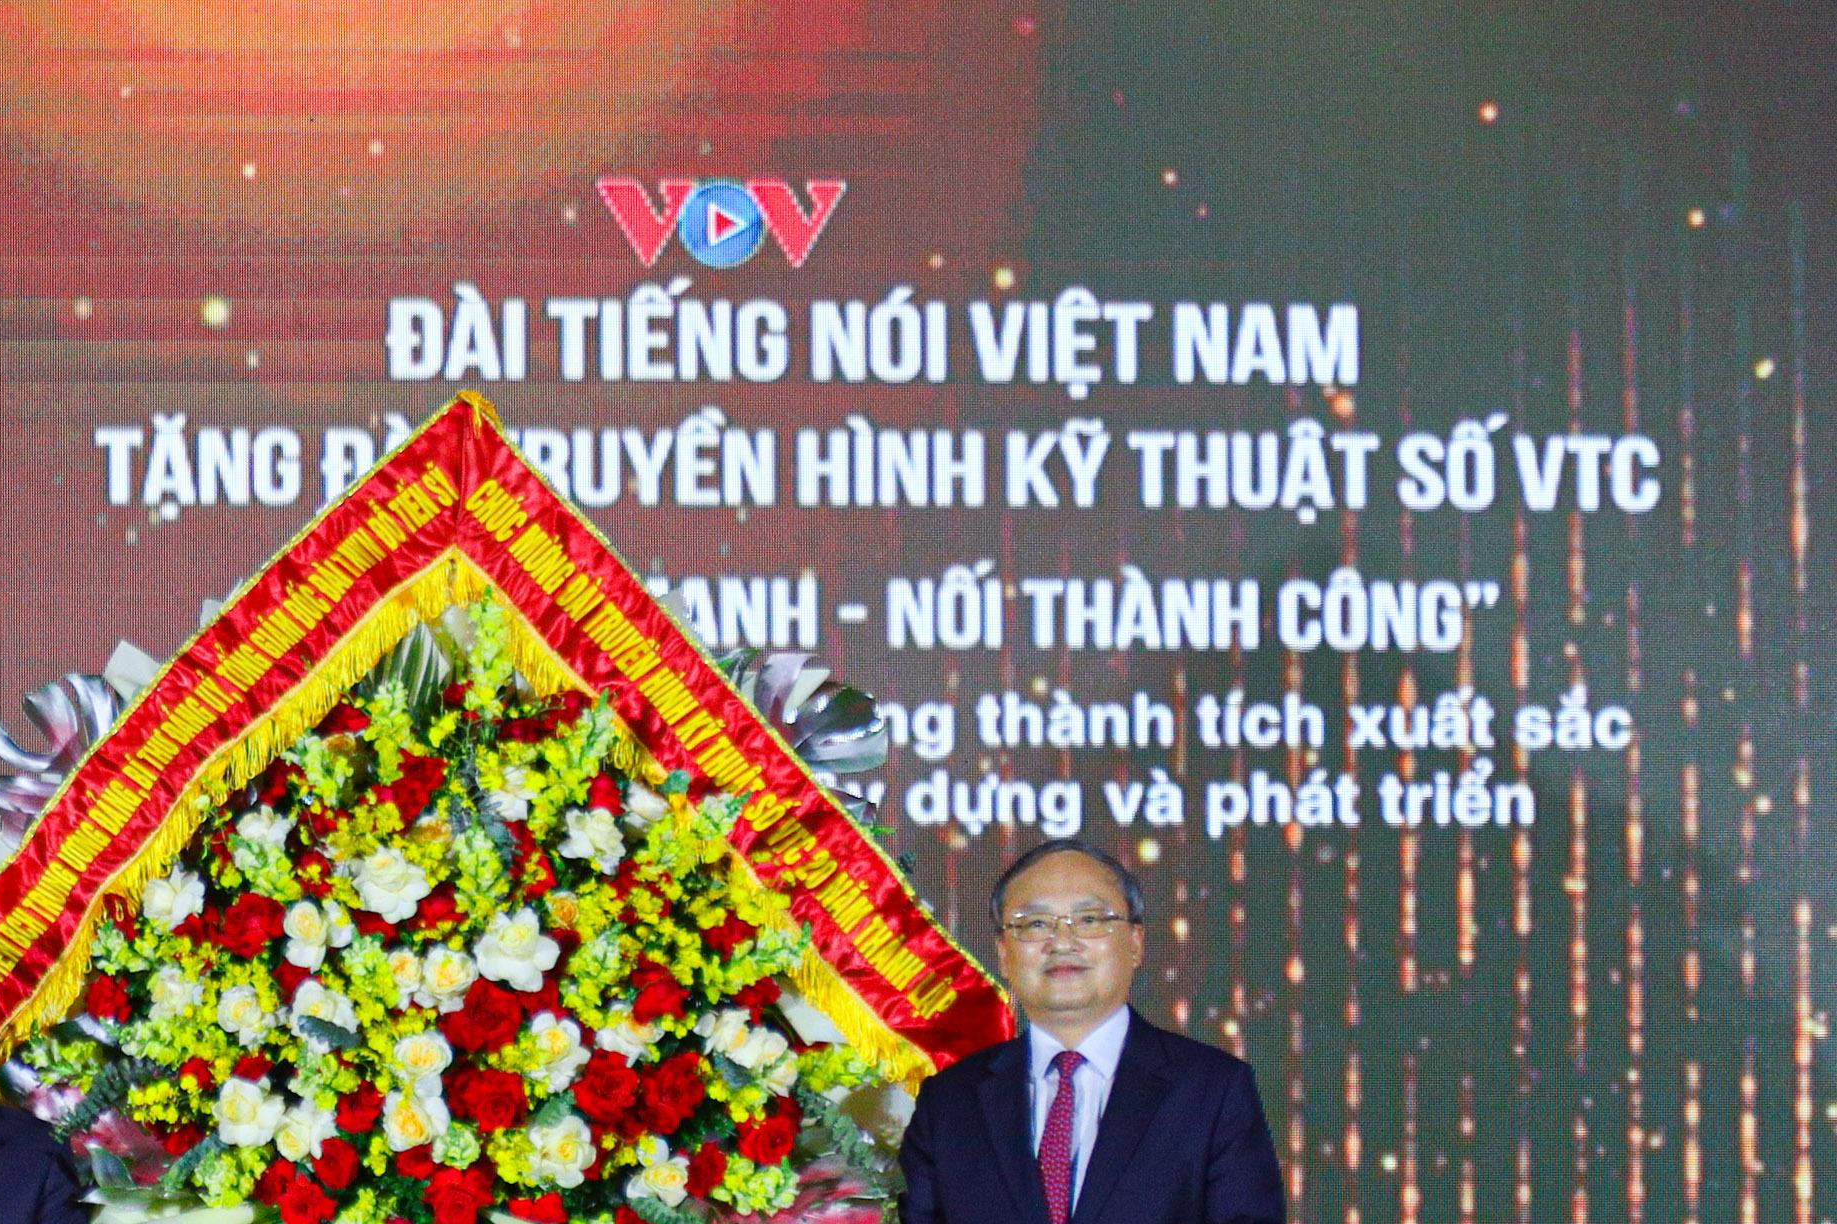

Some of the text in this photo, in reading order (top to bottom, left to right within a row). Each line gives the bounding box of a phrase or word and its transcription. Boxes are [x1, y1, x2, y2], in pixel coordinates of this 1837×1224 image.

[386, 277, 1358, 399] ĐÀI TIẾNG NÓI VIỆT NAM
[95, 412, 301, 521] TẶNG
[509, 406, 776, 507] RUYỀN
[798, 415, 984, 507] HÌNH
[1007, 419, 1109, 507] KỸ
[1128, 419, 1379, 524] THUẬT
[1399, 414, 1507, 510] SỐ
[1515, 433, 1659, 513] VTC
[888, 559, 1003, 649] NỐI
[1022, 565, 1258, 650] THÀNH
[1280, 566, 1499, 651] CÔNG”
[977, 686, 1173, 748] thành
[1198, 689, 1323, 748] tích
[1349, 682, 1493, 751] xuất
[1516, 684, 1633, 752] sắc
[906, 768, 1080, 837] dựng
[1105, 770, 1183, 825] và
[1208, 770, 1359, 838] phát
[1380, 759, 1534, 827] triển
